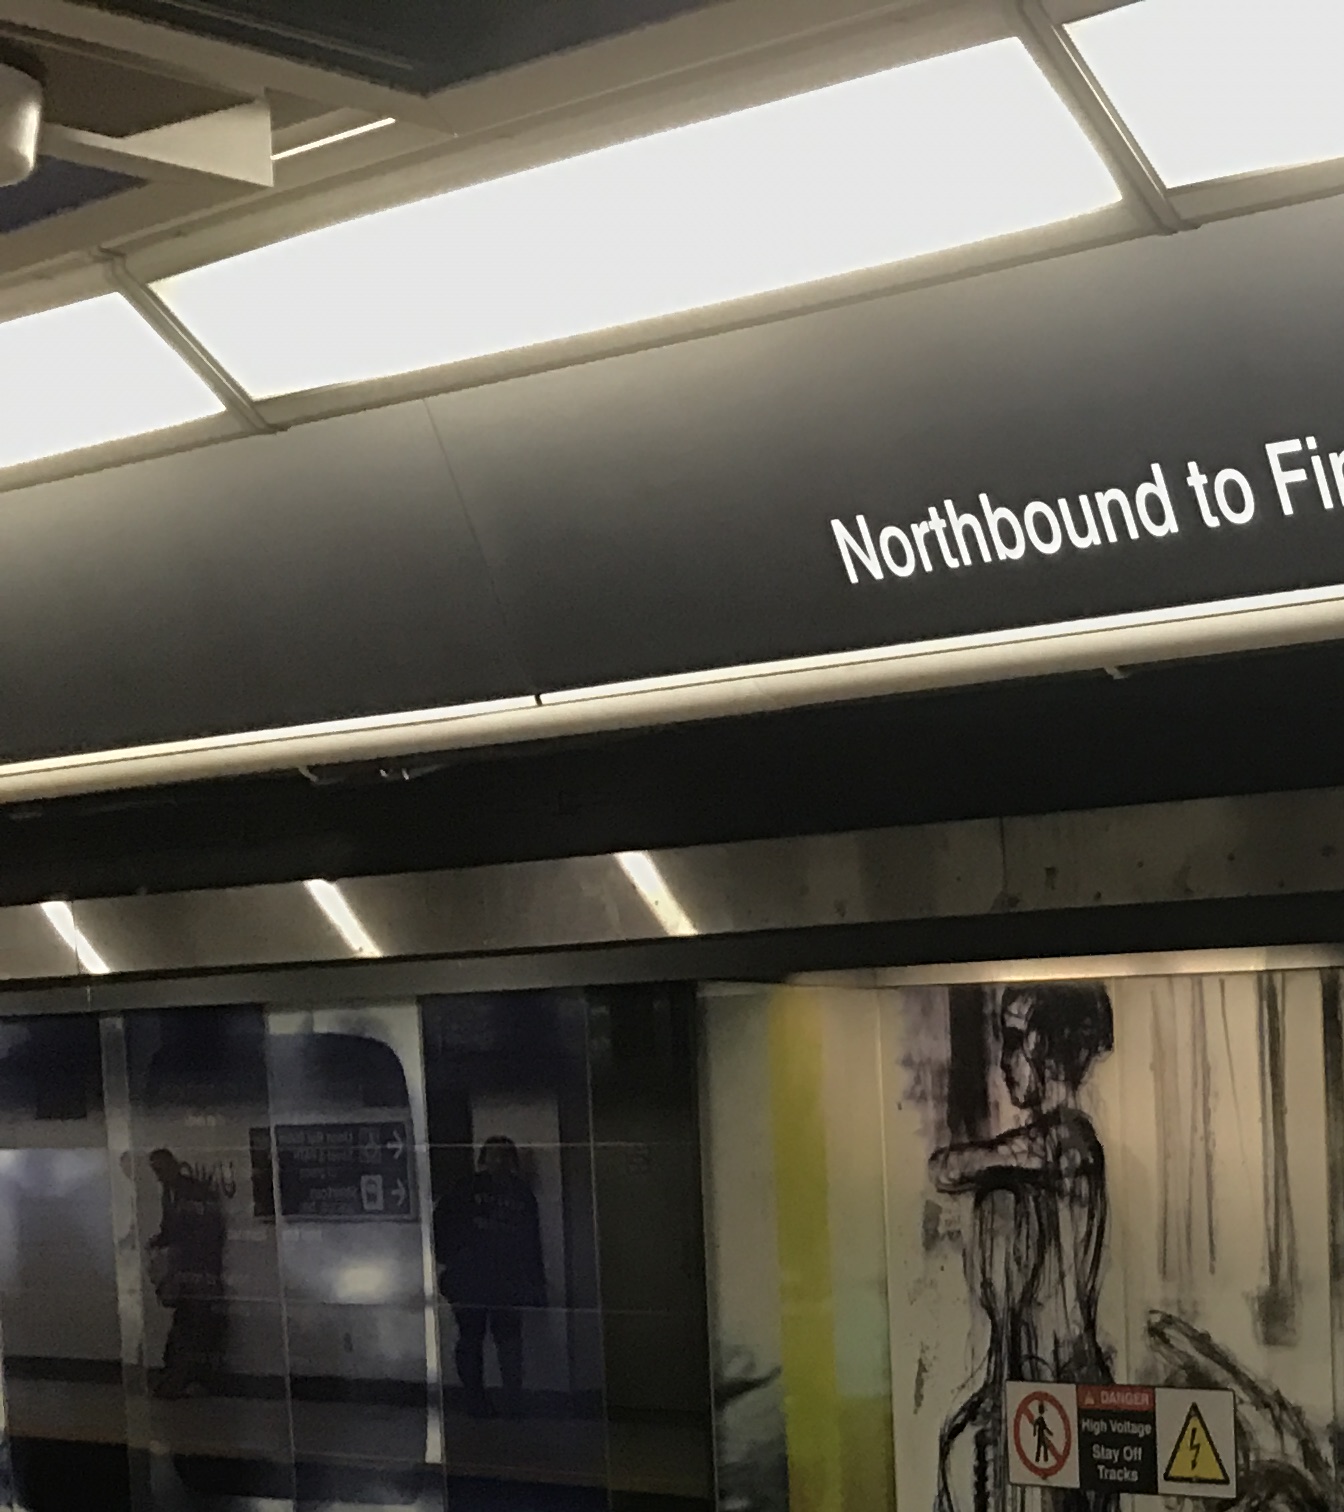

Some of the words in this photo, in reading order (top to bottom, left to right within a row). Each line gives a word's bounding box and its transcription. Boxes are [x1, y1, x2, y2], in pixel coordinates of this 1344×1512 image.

[830, 462, 1178, 585] Northbound
[1186, 460, 1255, 530] to
[1100, 1390, 1150, 1406] DANGER
[1081, 1418, 1108, 1436] High
[1109, 1419, 1152, 1438] Voltage
[1091, 1443, 1120, 1464] Stay
[1122, 1445, 1143, 1462] Off
[1097, 1464, 1139, 1482] Tracks
